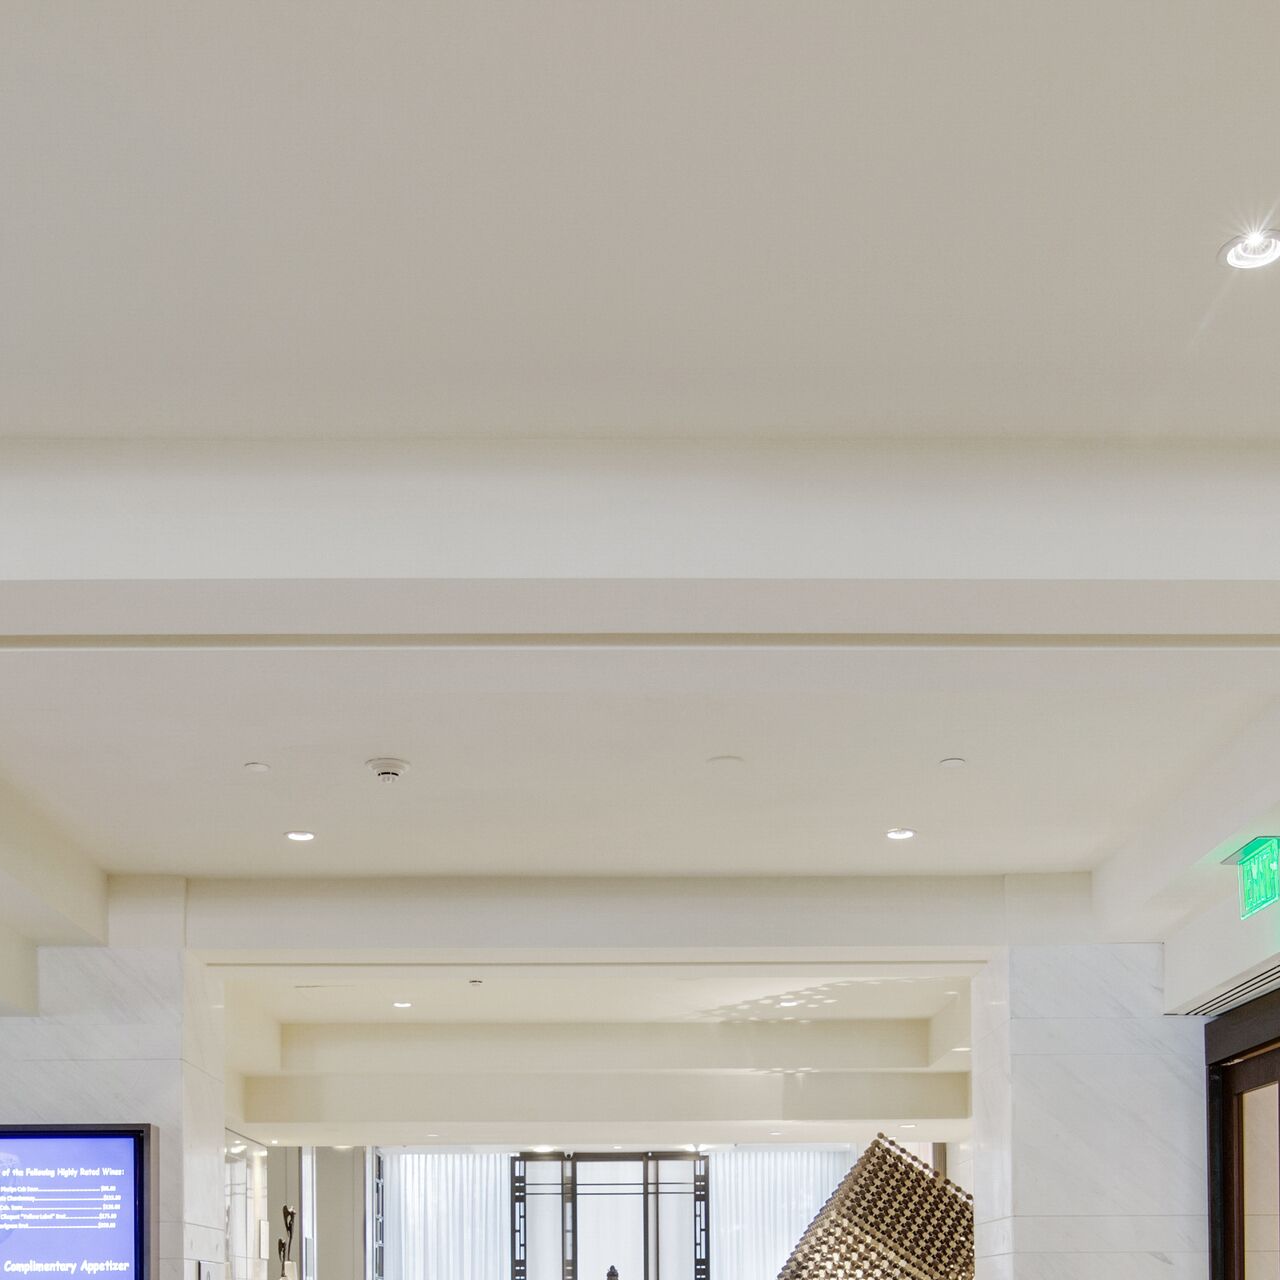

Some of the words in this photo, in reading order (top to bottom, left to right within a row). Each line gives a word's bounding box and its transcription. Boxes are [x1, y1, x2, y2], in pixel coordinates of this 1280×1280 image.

[1, 1168, 10, 1176] of
[12, 1168, 24, 1176] the
[57, 1168, 78, 1178] Highly
[79, 1168, 100, 1176] Rated
[3, 1259, 77, 1275] Complimentary
[80, 1259, 129, 1275] Appetizer
